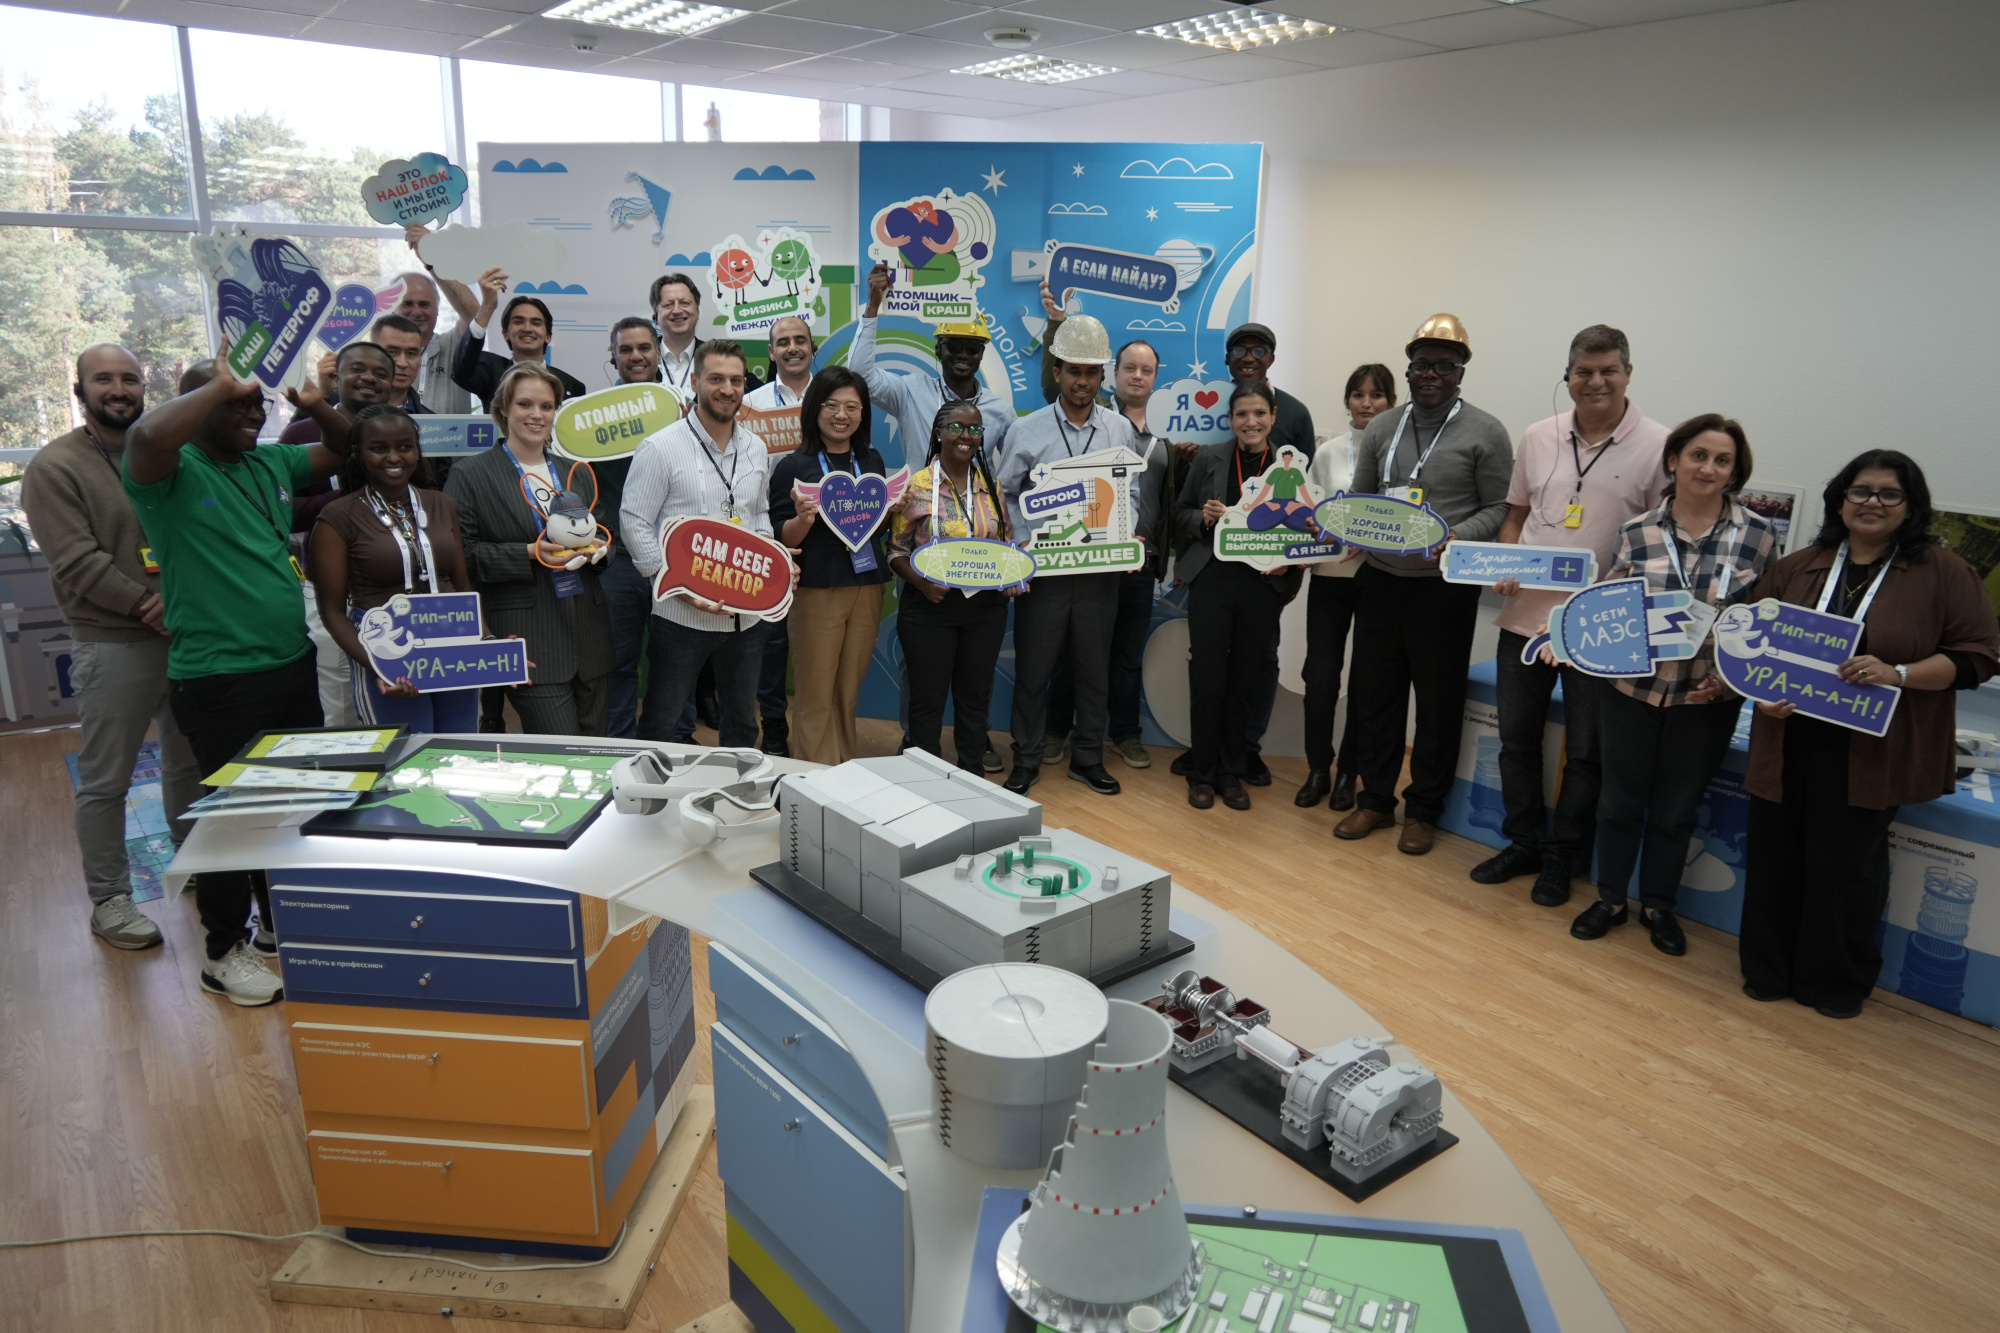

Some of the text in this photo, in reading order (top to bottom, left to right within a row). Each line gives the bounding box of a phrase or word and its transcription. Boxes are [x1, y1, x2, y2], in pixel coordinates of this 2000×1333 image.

[397, 168, 421, 183] ЭТО
[376, 183, 409, 202] НАШ
[392, 185, 446, 210] И МЫ ЕГО
[398, 195, 451, 220] СТРОИМ!
[1058, 256, 1167, 291] А ЕСЛИ НАЙДУ?
[885, 290, 959, 303] АТОМЩИК
[738, 300, 793, 317] ФИЗИКА
[887, 300, 968, 315] МОЙ КРАШ
[261, 286, 320, 374] ПЕТЕРГОФ
[731, 318, 775, 332] МЕЖДУ
[236, 331, 265, 369] НАШ
[980, 307, 1028, 392] ОЛОГИИ
[574, 390, 658, 431] АТОМНЫЙ
[1176, 394, 1189, 411] Я
[595, 418, 645, 445] ФРЕШ
[740, 418, 769, 433] ИЛА
[1166, 414, 1231, 433] ЛАЭС
[764, 431, 802, 447] ТОЛЬК
[1029, 488, 1081, 509] СТРОЮ
[840, 512, 871, 525] ЛЮБОВЬ
[1365, 505, 1394, 515] ТОЛЬКО
[1352, 517, 1401, 533] ХОРОШАЯ
[1226, 533, 1315, 542] ЯДЕРНОЕ ТОПЛ
[1345, 527, 1406, 544] ЭНЕРГЕТИКА
[691, 532, 773, 578] САМ СЕБЕ
[961, 547, 988, 555] ТОЛЬКО
[1225, 543, 1285, 551] ВЫГОРАЕТ
[1289, 544, 1334, 556] А Я НЕТ
[951, 560, 996, 570] ХОРОШАЯ
[1033, 547, 1135, 568] БУДУЩЕЕ
[690, 555, 764, 597] РЕАКТОР
[946, 570, 1002, 580] ЭНЕРГЕТИКА
[410, 611, 474, 625] ГИП-ГИП
[1579, 606, 1628, 627] В СЕТИ
[1580, 618, 1641, 650] ЛАЭС
[1772, 621, 1848, 650] ГИП-ГИП
[1899, 845, 1951, 864] поколения
[1907, 837, 1975, 860] современный
[279, 899, 349, 910] Электровикторина
[288, 957, 307, 966] Игра
[337, 960, 383, 969] профессию»
